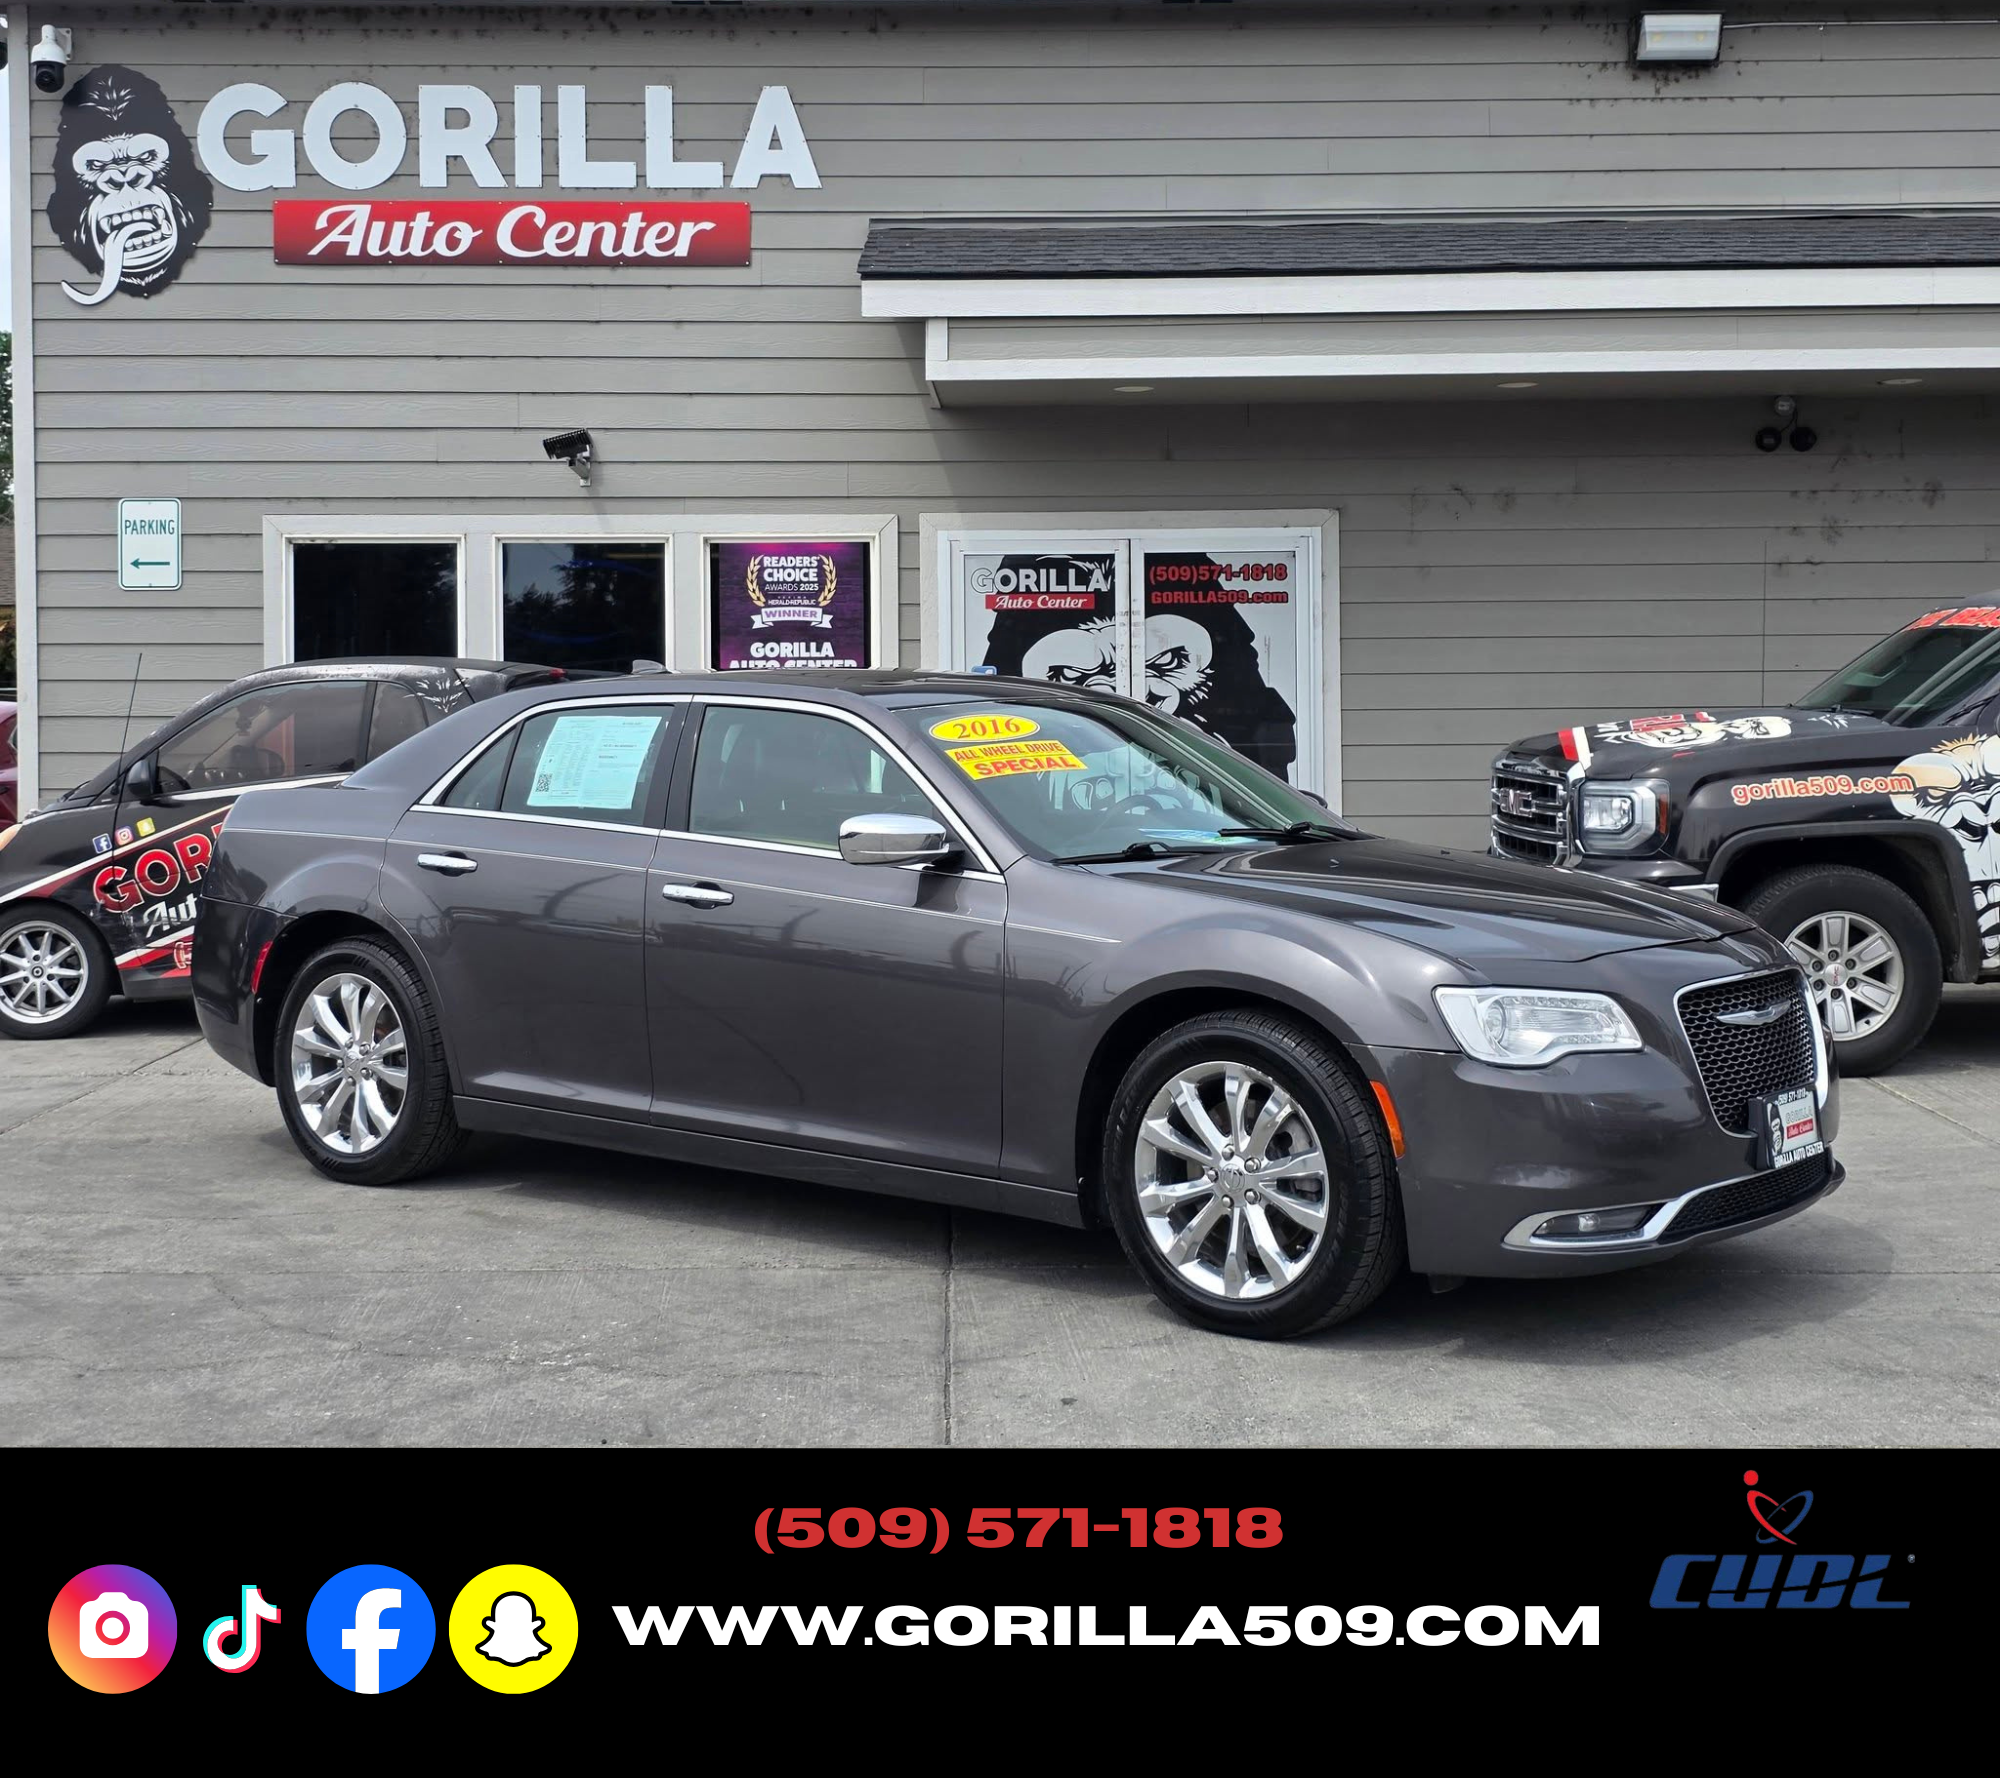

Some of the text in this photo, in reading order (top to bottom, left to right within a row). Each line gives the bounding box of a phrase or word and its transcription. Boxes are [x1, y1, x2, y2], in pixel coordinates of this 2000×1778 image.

[197, 82, 822, 191] GORILLA
[307, 203, 716, 258] Auto Center
[124, 519, 175, 535] PARKING
[763, 556, 820, 567] READERS'
[763, 568, 818, 582] CHOICE
[971, 567, 1109, 593] GORILLA
[1149, 563, 1288, 585] (509)571-1818
[764, 583, 819, 591] AWARDS 2025
[1150, 589, 1289, 604] GORILLA509.com
[994, 595, 1087, 609] Auto Center
[764, 610, 818, 618] WINNER
[750, 642, 835, 658] GORILLA
[953, 718, 1020, 739] 2016
[954, 742, 1063, 762] ALL WHEEL DRIVE
[974, 756, 1077, 776] SPECIAL
[1731, 774, 1914, 805] gorilla509.com
[93, 822, 223, 913] GOR
[142, 892, 198, 939] Aut
